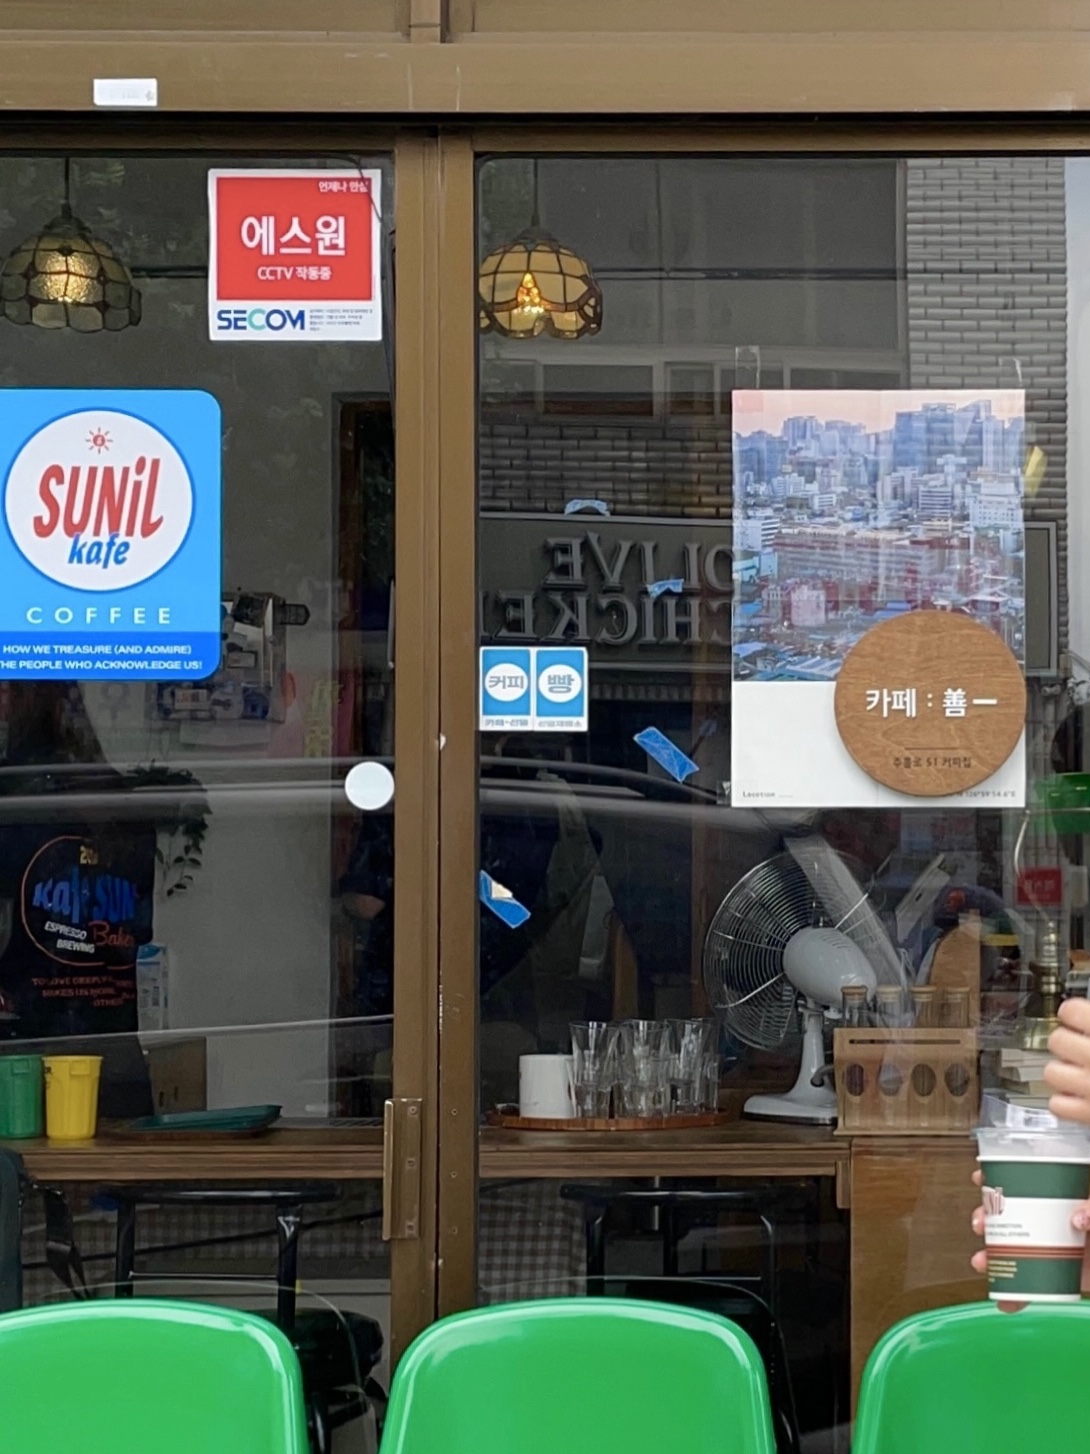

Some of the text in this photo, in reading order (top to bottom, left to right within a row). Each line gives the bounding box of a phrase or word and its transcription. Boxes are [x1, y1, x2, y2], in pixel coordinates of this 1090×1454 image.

[241, 215, 346, 256] 에스원
[257, 266, 332, 281] CCTV 작동중
[217, 308, 305, 331] SECOM
[68, 532, 131, 569] kafe
[26, 607, 171, 624] COFFEE
[32, 644, 51, 655] WE
[53, 644, 113, 655] TREASURE
[114, 644, 143, 656] (AND
[144, 644, 192, 656] ADMIRE)
[18, 660, 62, 670] PEOPLE
[64, 660, 92, 670] WHO
[94, 660, 182, 670] ACKNOWLEDGE
[183, 660, 203, 670] US!
[488, 675, 524, 689] 커피
[547, 674, 575, 694] 빵
[866, 688, 917, 718] 카페
[942, 688, 998, 718] 善一
[941, 756, 972, 769] 커피집
[45, 921, 88, 941] ESPRESSO
[56, 938, 96, 953] BREWING
